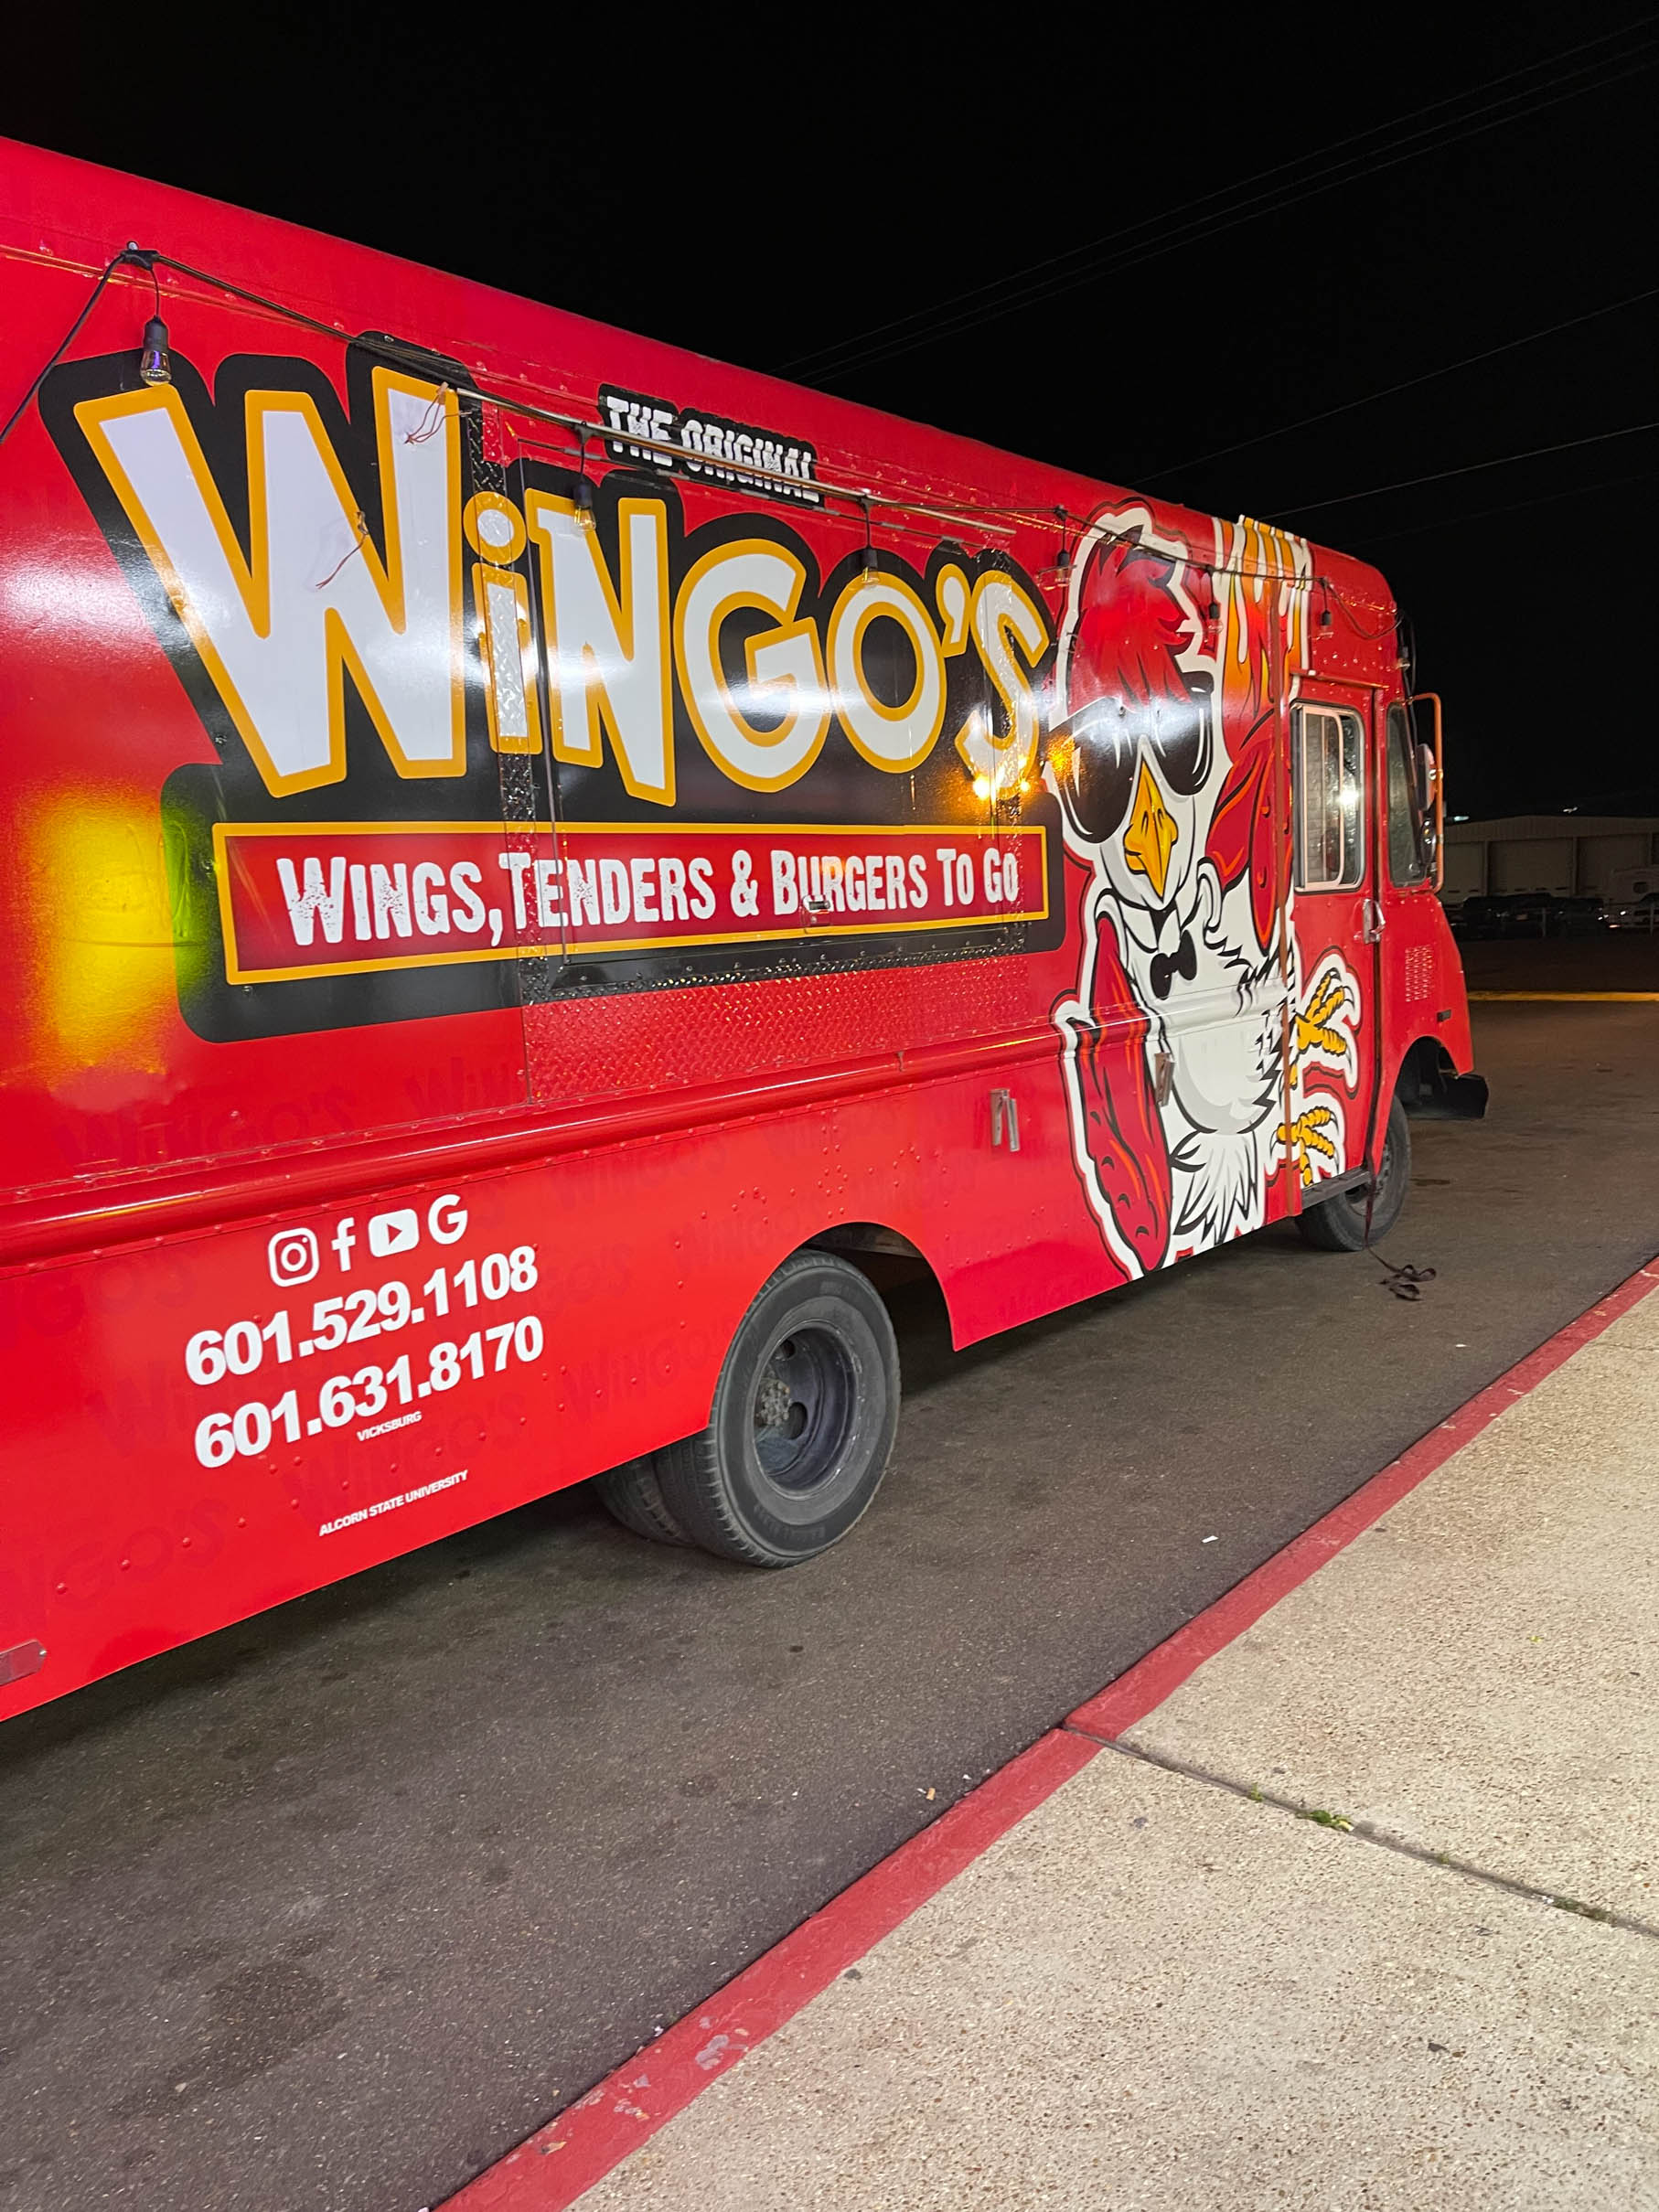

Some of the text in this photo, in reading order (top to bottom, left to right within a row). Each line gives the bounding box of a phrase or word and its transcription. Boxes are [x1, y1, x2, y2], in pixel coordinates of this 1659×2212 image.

[606, 395, 819, 503] THE ORIGINAL
[731, 849, 759, 918] &
[770, 850, 928, 916] BURGERS
[185, 1245, 539, 1386] 601.529.1108
[194, 1315, 544, 1469] 601.631.8170
[357, 1411, 423, 1442] VICKSBURG
[318, 1469, 469, 1536] ALCORN STATE UNIVERSITY
